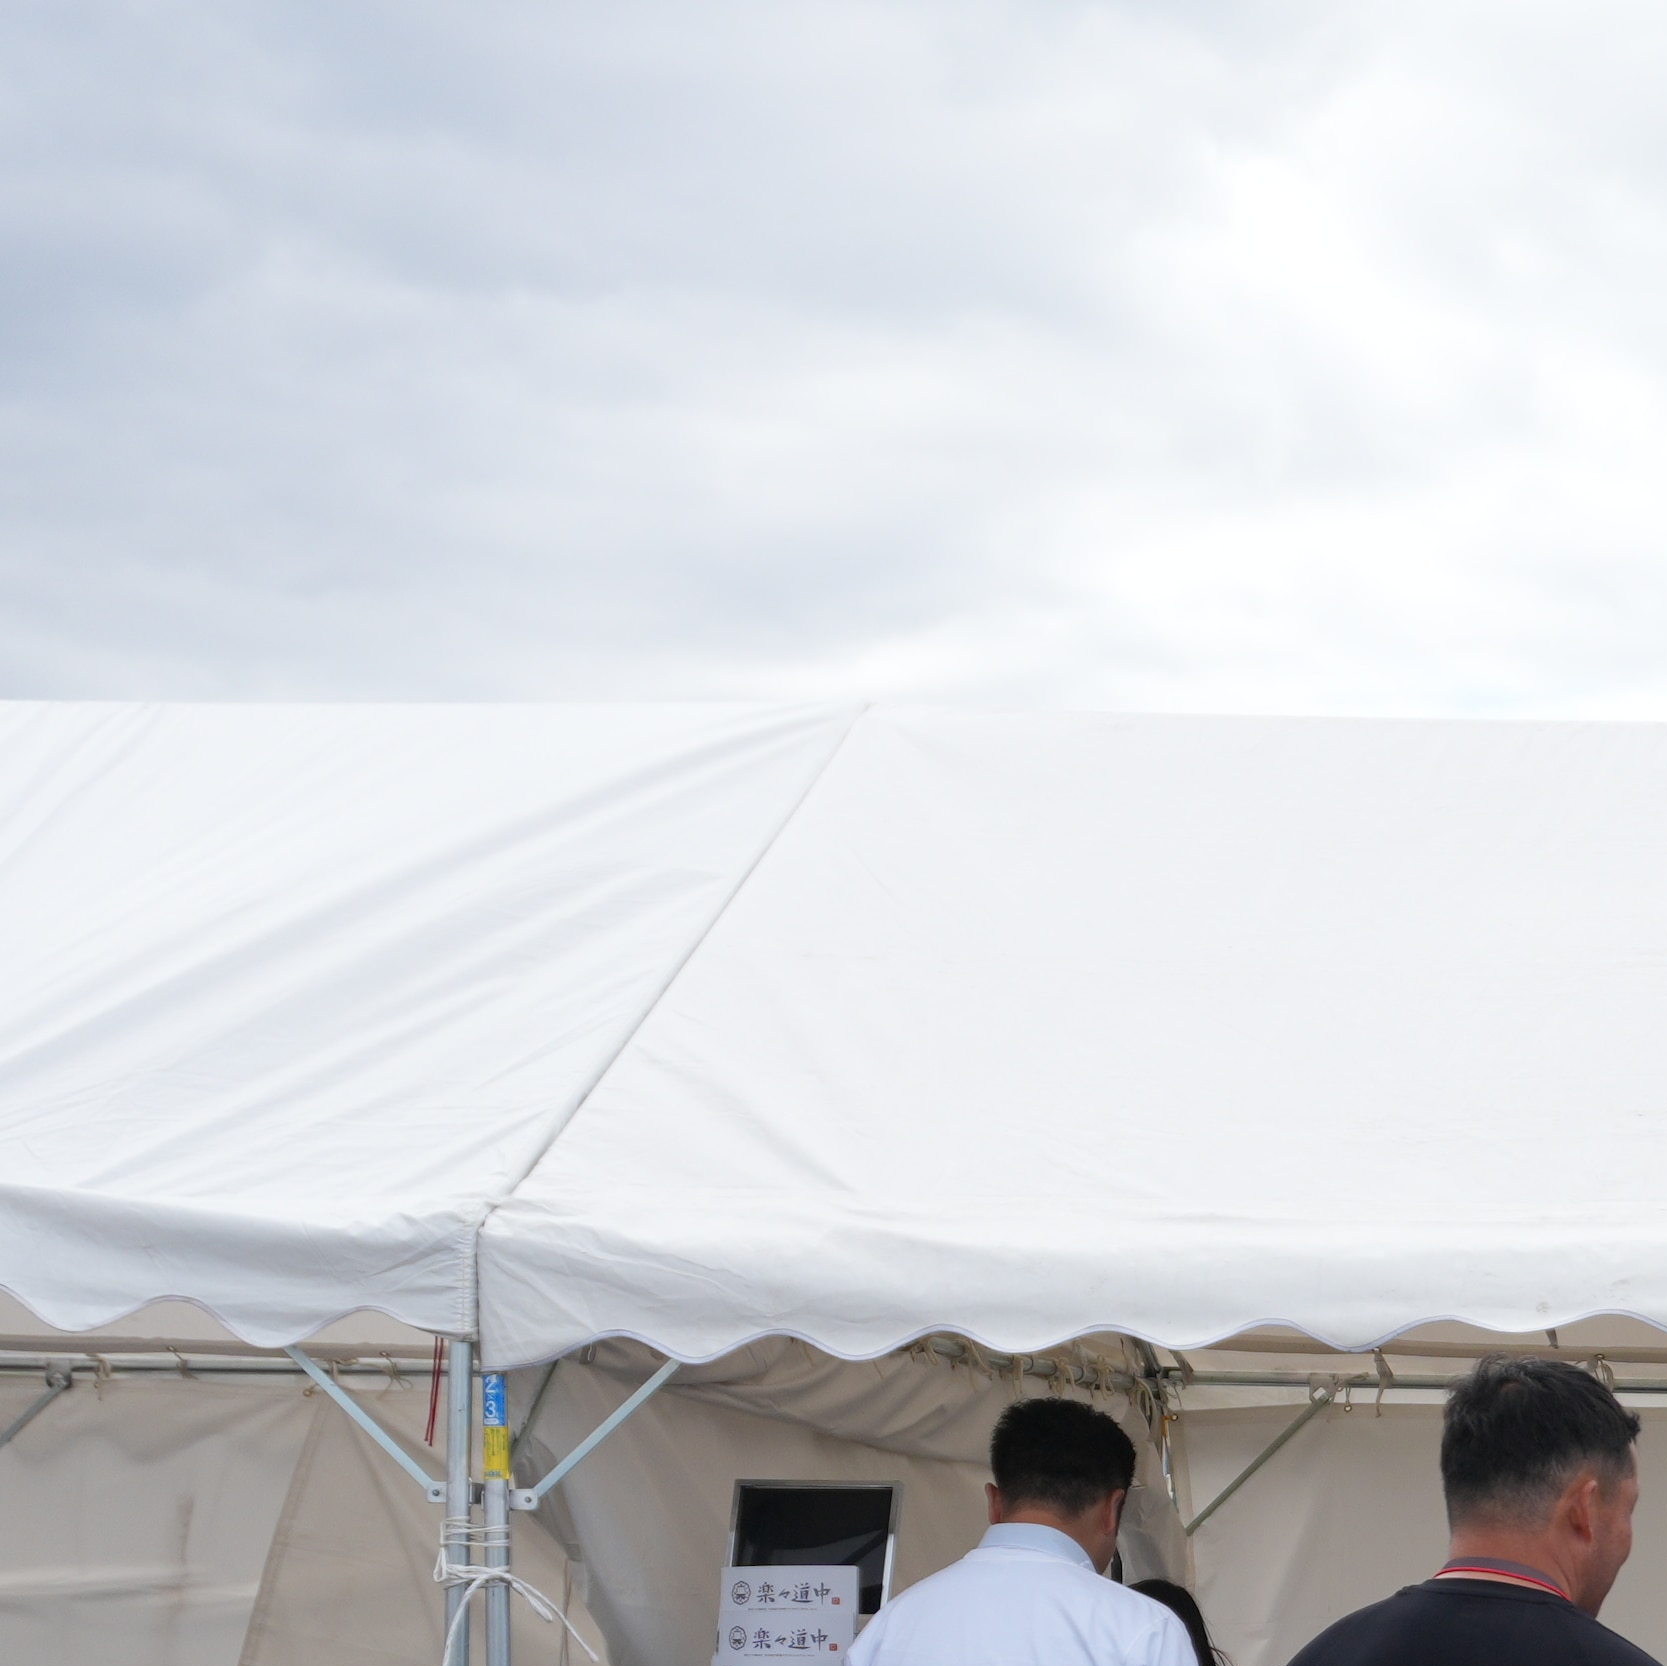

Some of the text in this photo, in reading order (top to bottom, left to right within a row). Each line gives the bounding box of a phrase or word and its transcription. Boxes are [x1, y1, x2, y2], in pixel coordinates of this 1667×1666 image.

[756, 1582, 831, 1605] 楽々道中
[753, 1628, 828, 1651] 楽々道中
